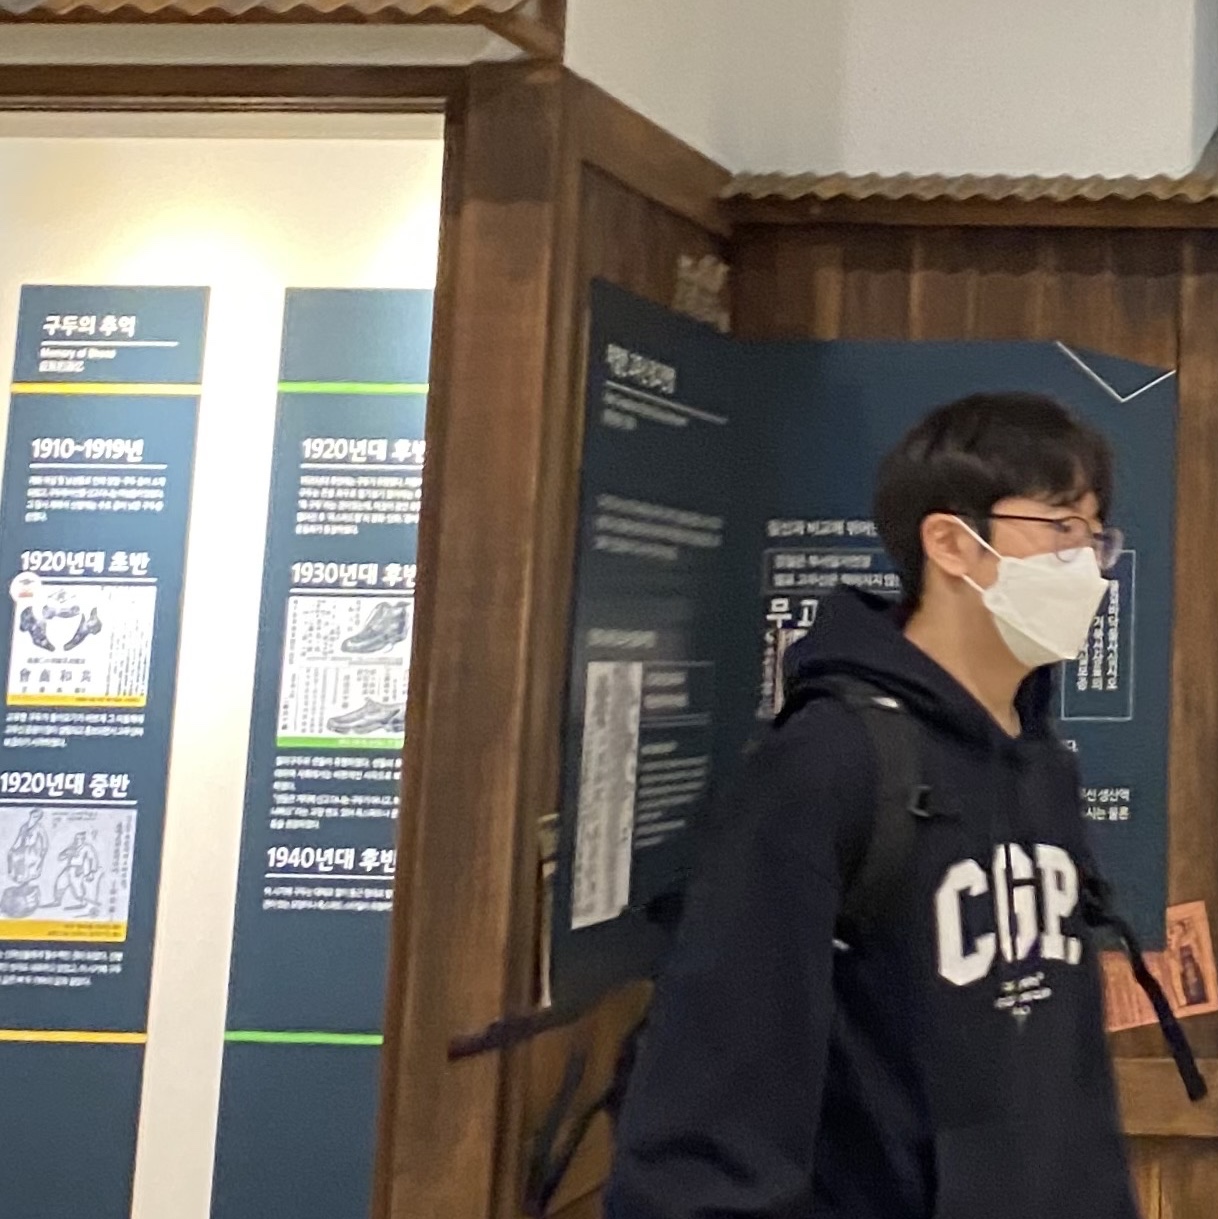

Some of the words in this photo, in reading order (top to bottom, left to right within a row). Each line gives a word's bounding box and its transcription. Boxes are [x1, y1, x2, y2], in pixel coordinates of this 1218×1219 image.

[43, 315, 96, 336] 구두의
[99, 315, 137, 337] 추억
[31, 438, 144, 462] 1910~1919년
[302, 438, 388, 462] 1920년대
[20, 551, 105, 574] 1920년대
[108, 551, 151, 575] 초반
[291, 562, 378, 586] 1930년대
[0, 772, 85, 796] 1920년대
[89, 773, 130, 798] 중반
[267, 847, 355, 871] 1940년대
